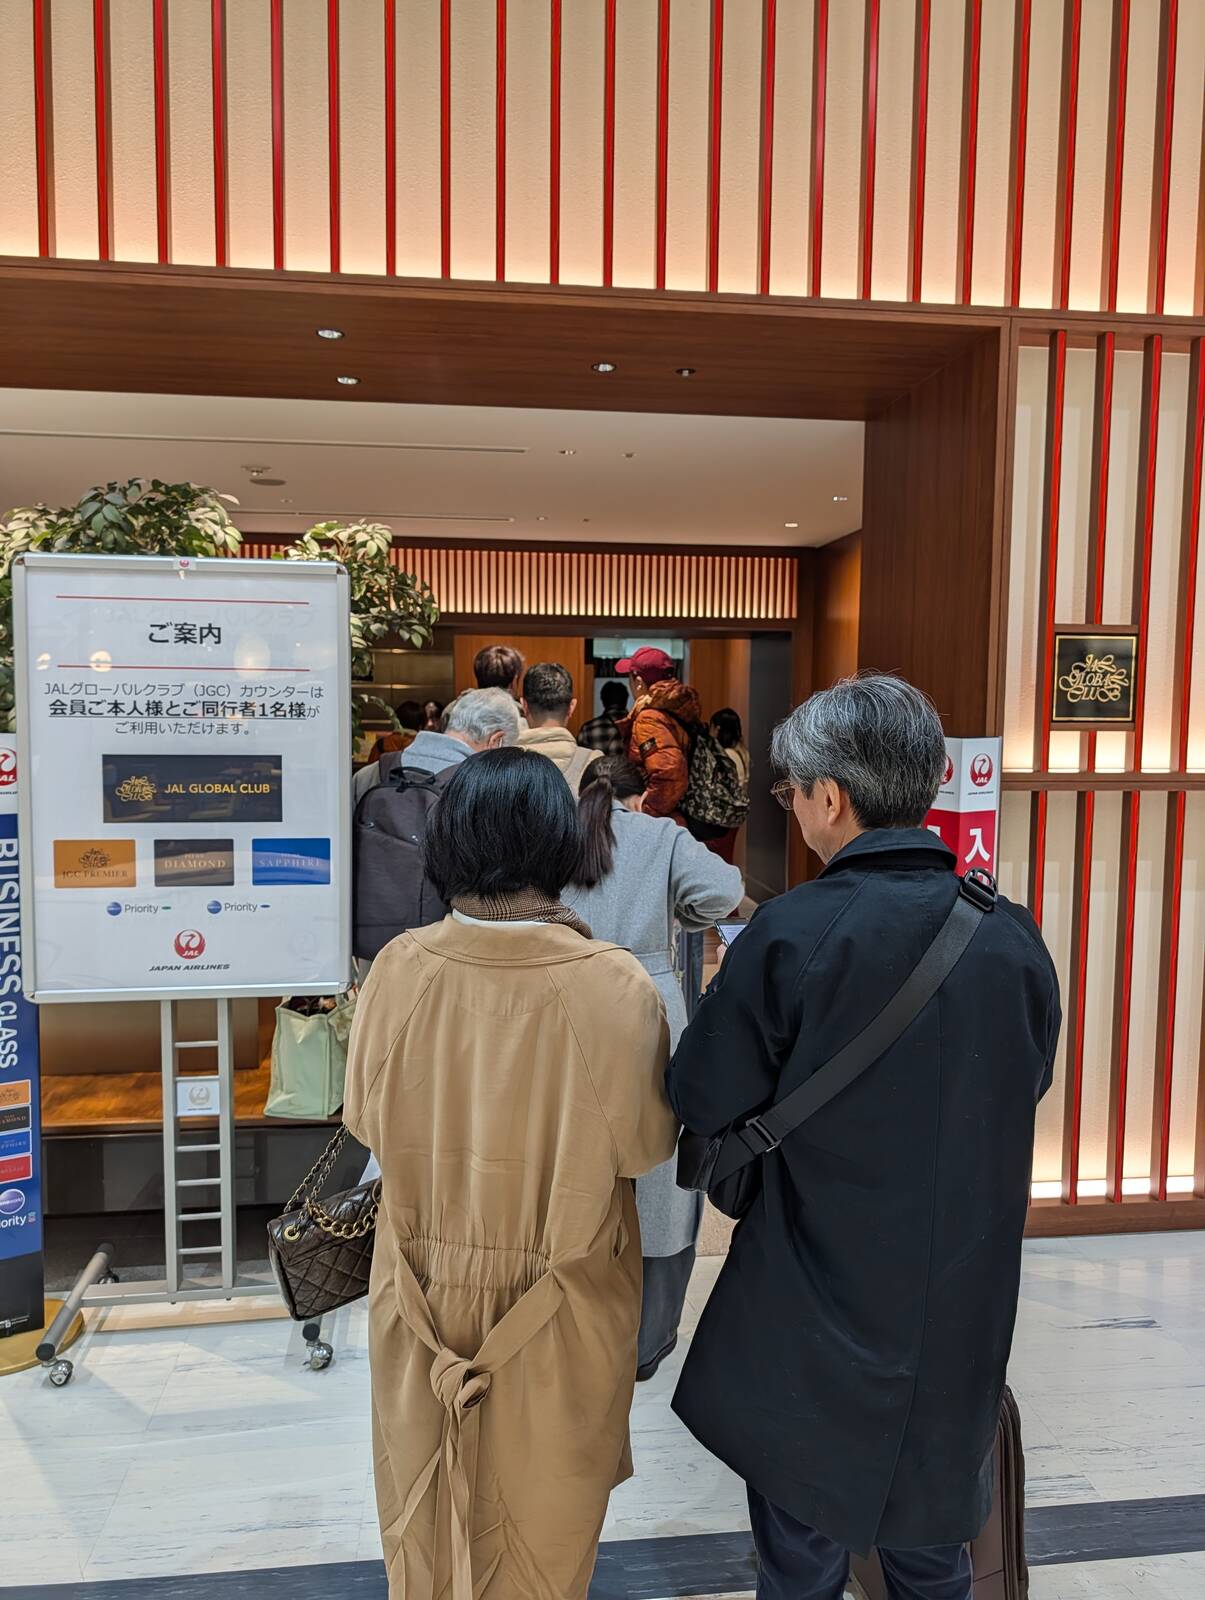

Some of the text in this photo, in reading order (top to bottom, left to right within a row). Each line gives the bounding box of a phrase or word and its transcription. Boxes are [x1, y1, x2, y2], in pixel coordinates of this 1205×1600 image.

[148, 622, 222, 645] ご案内
[48, 699, 320, 719] 会員ご本人様とご同行者1名様が
[114, 721, 250, 736] ご利用いただけます。
[0, 774, 16, 782] AL
[164, 783, 271, 794] JAL GLOBAL CLUB
[163, 859, 226, 869] DIAMOND
[258, 858, 321, 868] SAPPHIRE
[124, 903, 159, 914] Priority
[224, 902, 258, 912] Priority
[183, 963, 230, 971] AIRLINES
[0, 1001, 18, 1069] CLASS
[0, 1214, 28, 1228] ority
